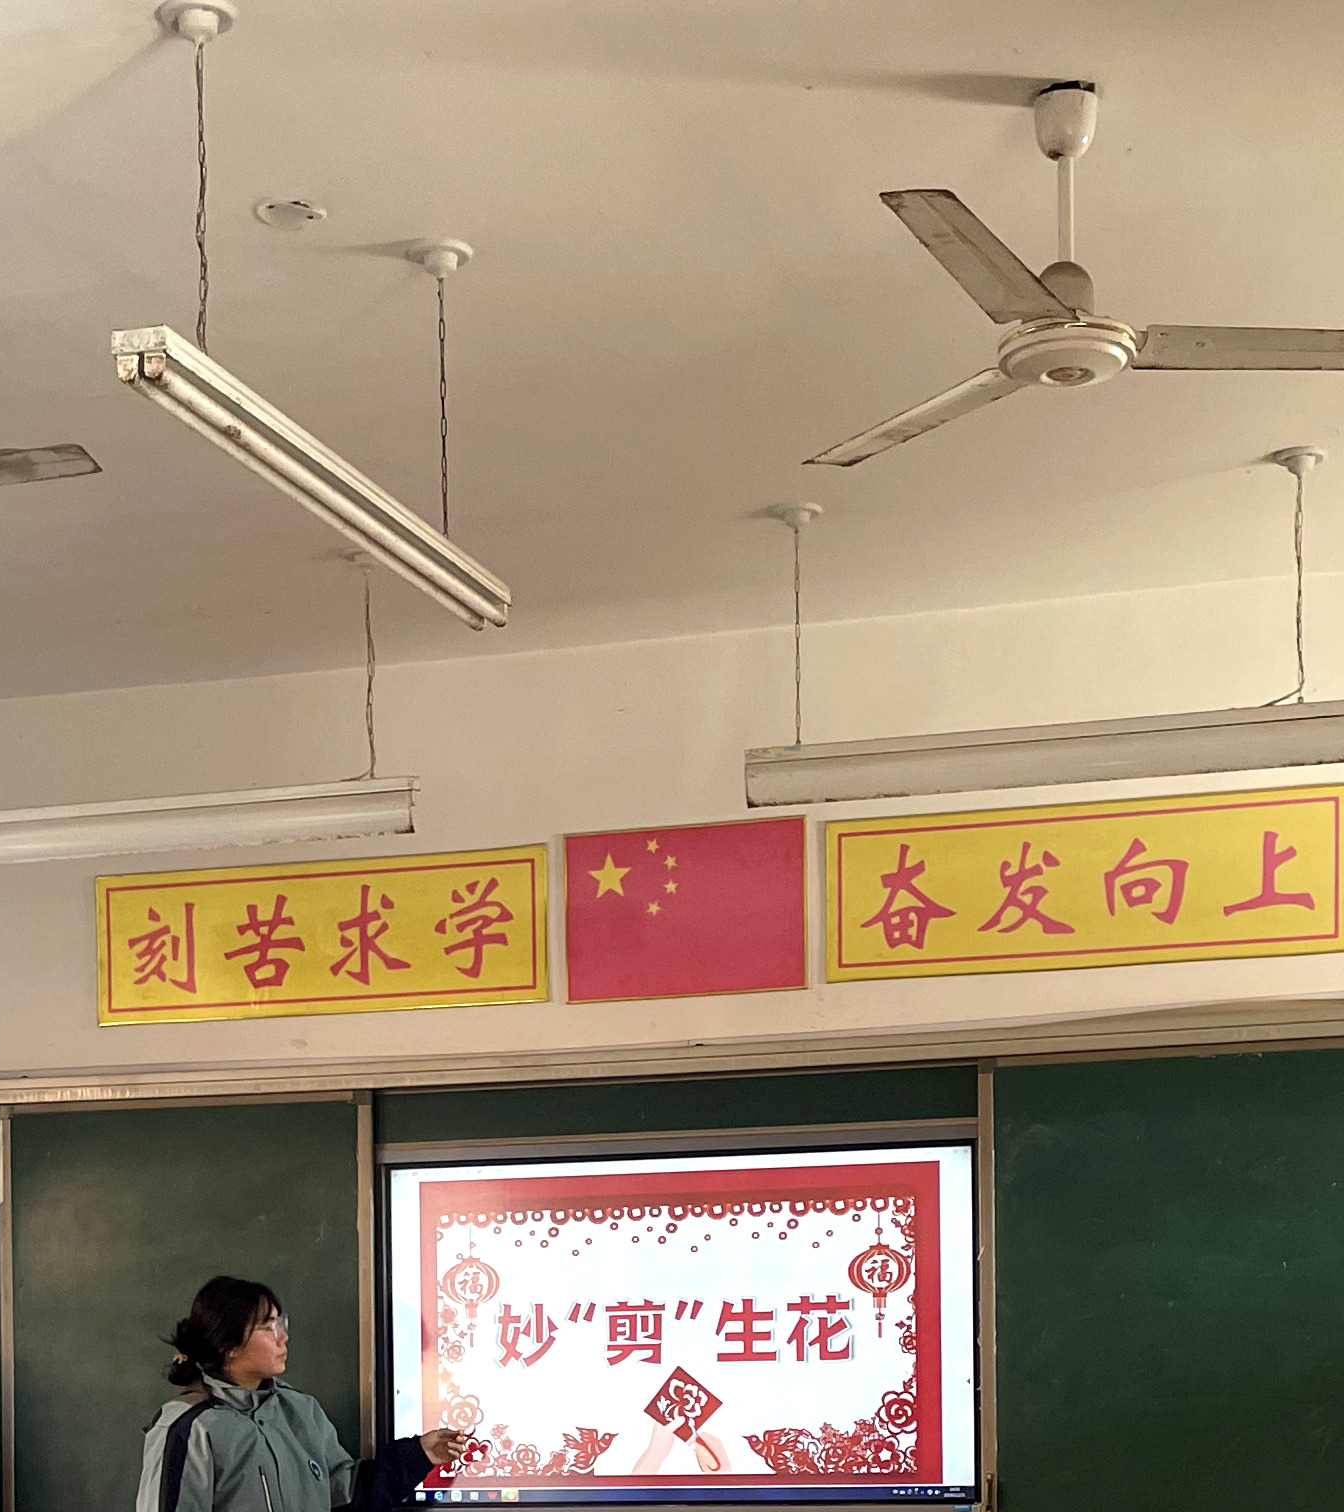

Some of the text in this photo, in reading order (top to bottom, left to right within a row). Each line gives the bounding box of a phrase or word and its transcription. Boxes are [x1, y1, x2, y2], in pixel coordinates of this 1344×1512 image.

[861, 831, 1317, 950] 奋发向上
[127, 877, 518, 994] 刻苦求学
[458, 1270, 484, 1296] 福
[865, 1257, 894, 1284] 福
